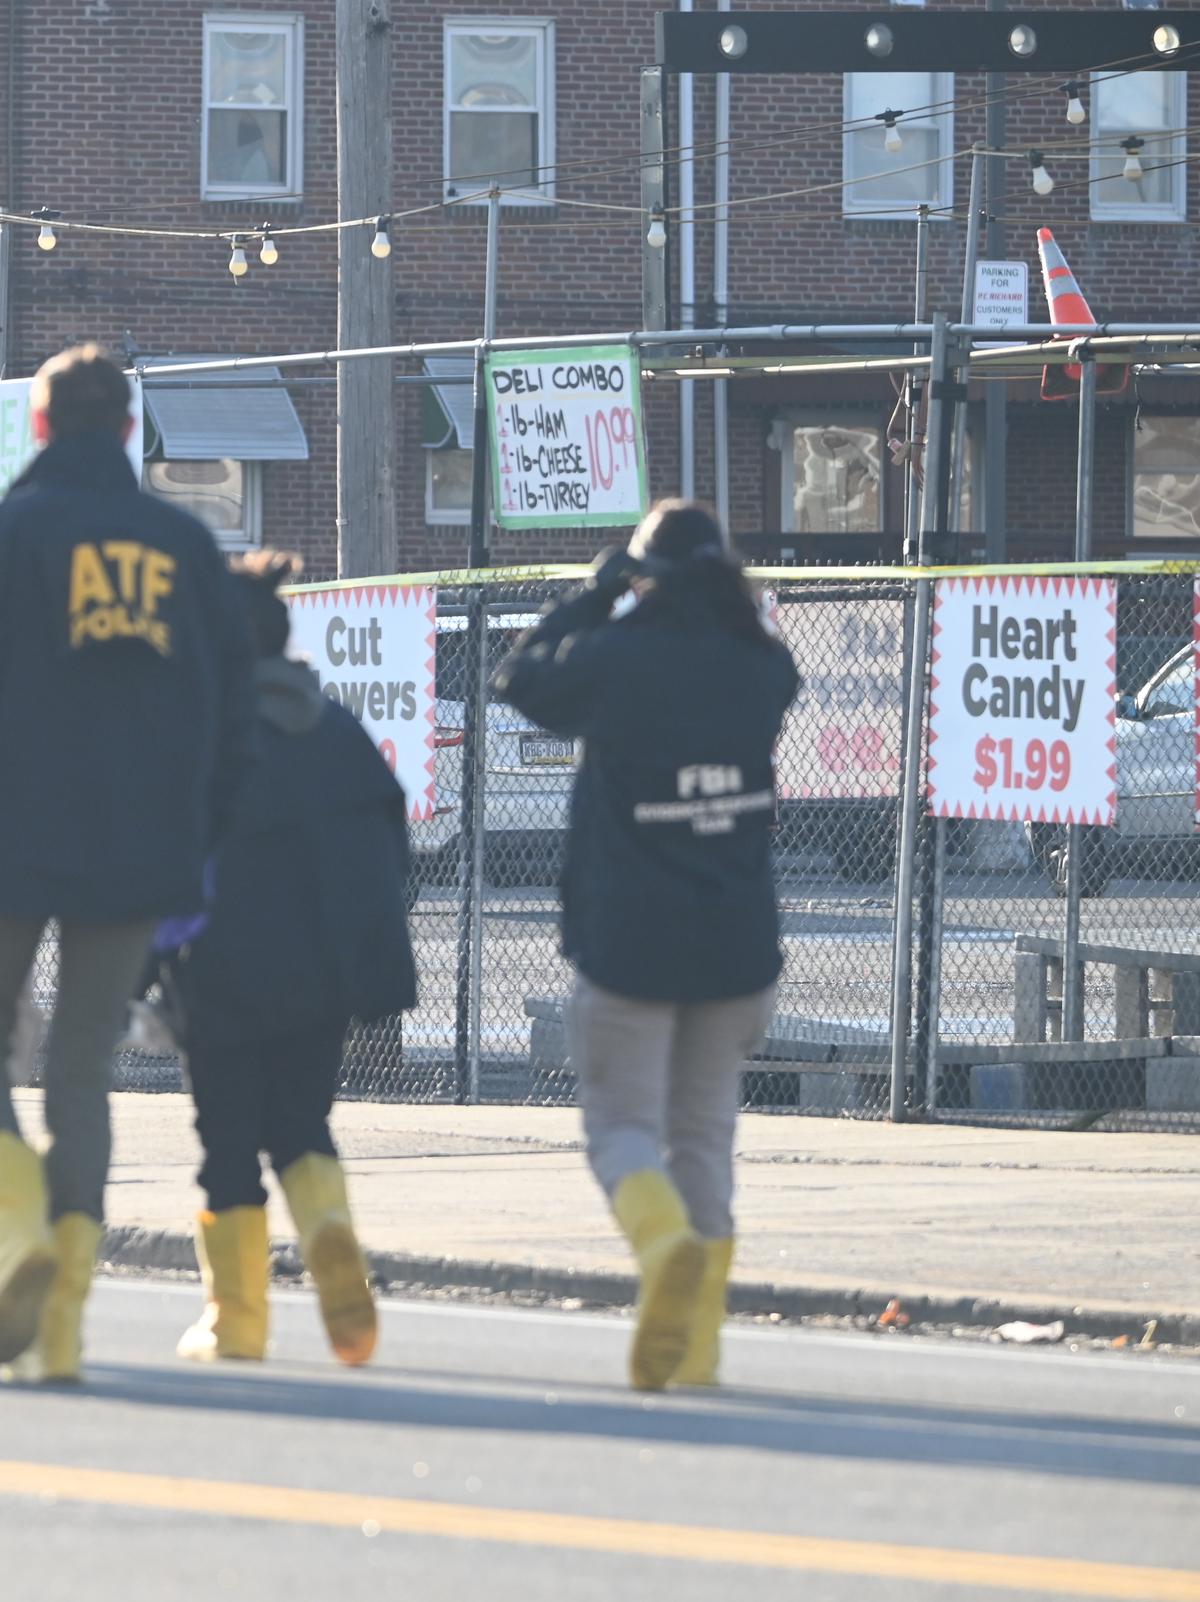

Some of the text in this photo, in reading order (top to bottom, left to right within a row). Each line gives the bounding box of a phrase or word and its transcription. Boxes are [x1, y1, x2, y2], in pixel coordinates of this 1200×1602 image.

[982, 267, 1019, 277] PARKING
[991, 279, 1009, 288] FOR
[976, 305, 1023, 314] CUSTOMERS
[990, 317, 1008, 325] ONLY
[492, 364, 624, 394] DELI COMBO
[69, 541, 176, 614] ATF
[325, 616, 382, 667] Cut
[972, 604, 1077, 662] Heart
[962, 662, 1085, 733] Candy
[973, 733, 1071, 794] $1.99
[677, 764, 743, 800] FBI
